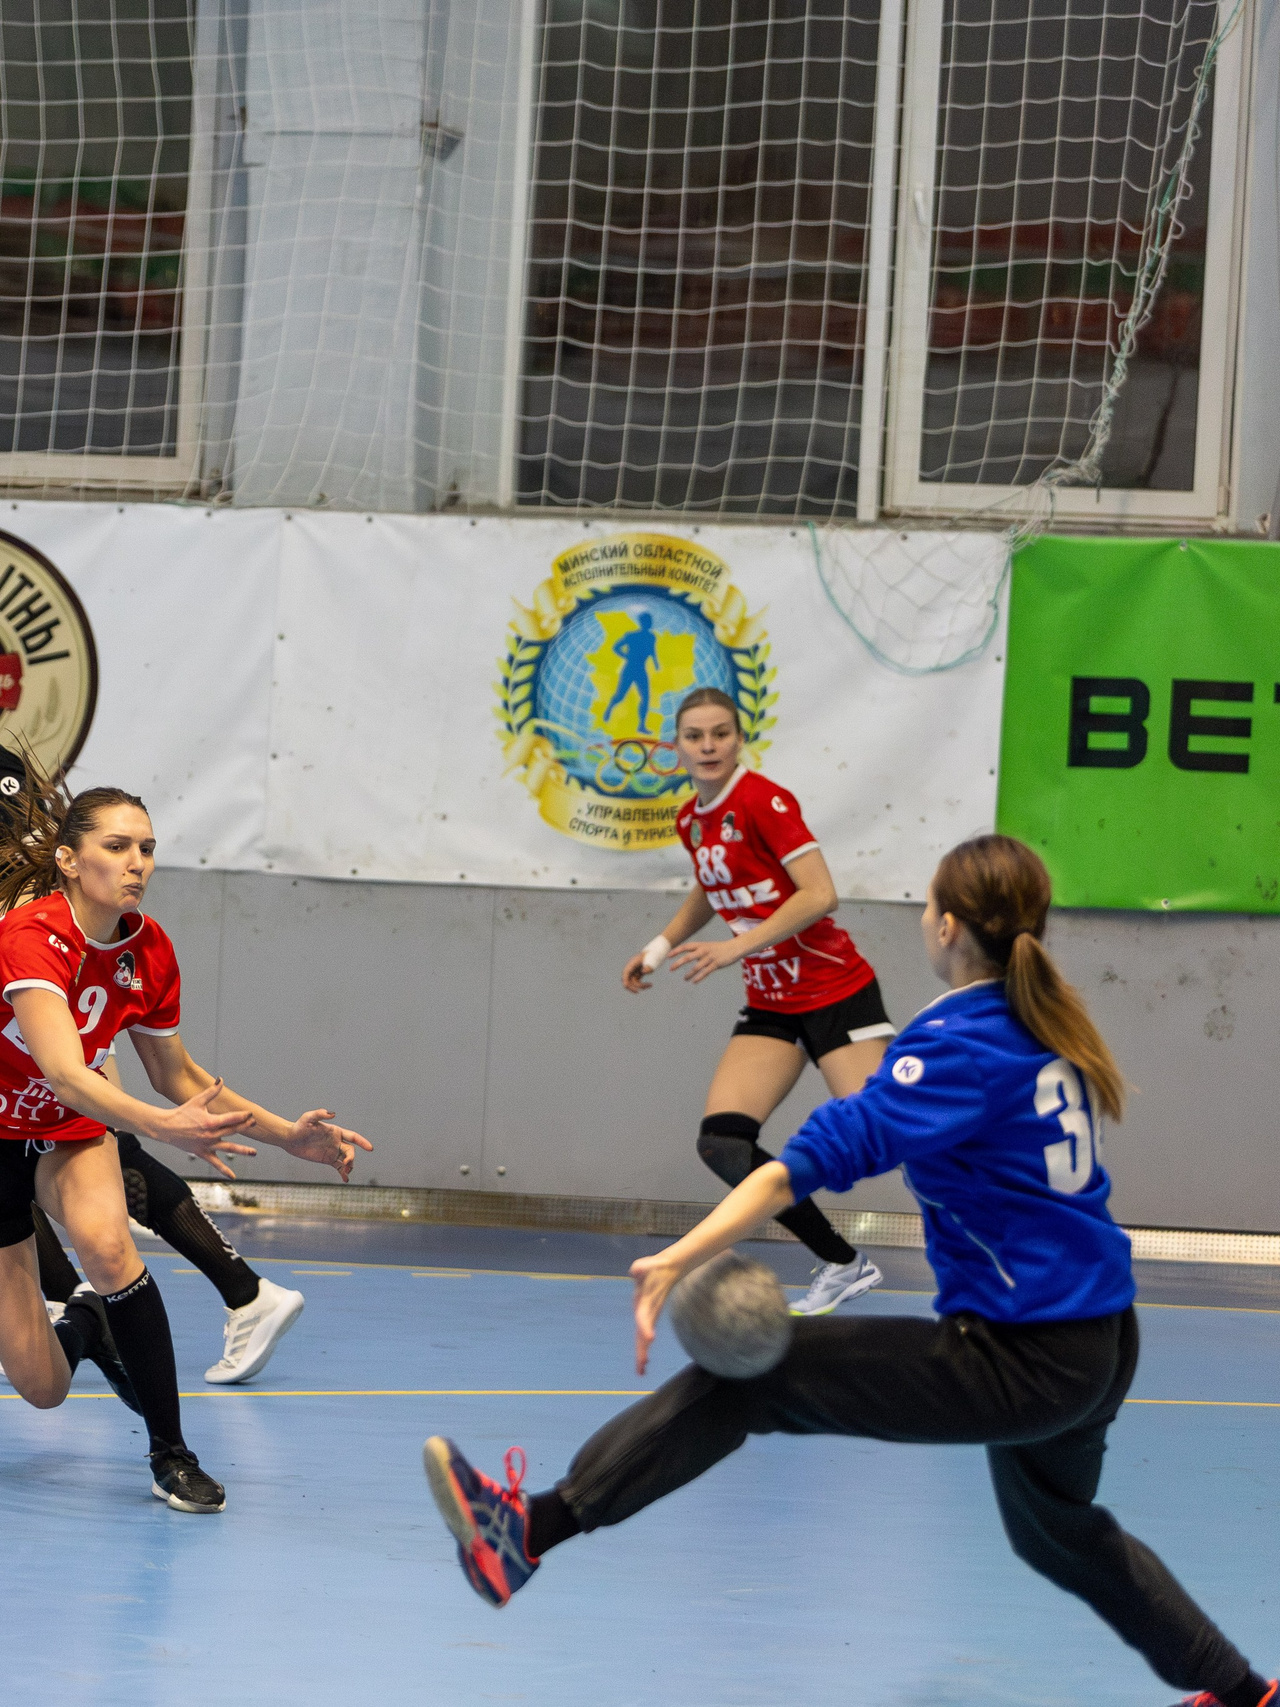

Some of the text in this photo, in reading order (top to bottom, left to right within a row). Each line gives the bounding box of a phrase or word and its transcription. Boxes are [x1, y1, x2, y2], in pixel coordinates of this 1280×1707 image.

[557, 541, 724, 580] МИНСКИЙ ОБЛАСТНОЙ
[563, 562, 719, 594] ИСПОЛНИТЕЛЬНЫЙ КОМИТЕТ
[1067, 674, 1280, 775] BE
[568, 817, 619, 840] СПОРТА
[586, 802, 679, 822] УПРАВЛЕНИЕ
[696, 844, 733, 887] 88
[77, 985, 108, 1034] 9
[106, 1271, 150, 1304] Kemp
